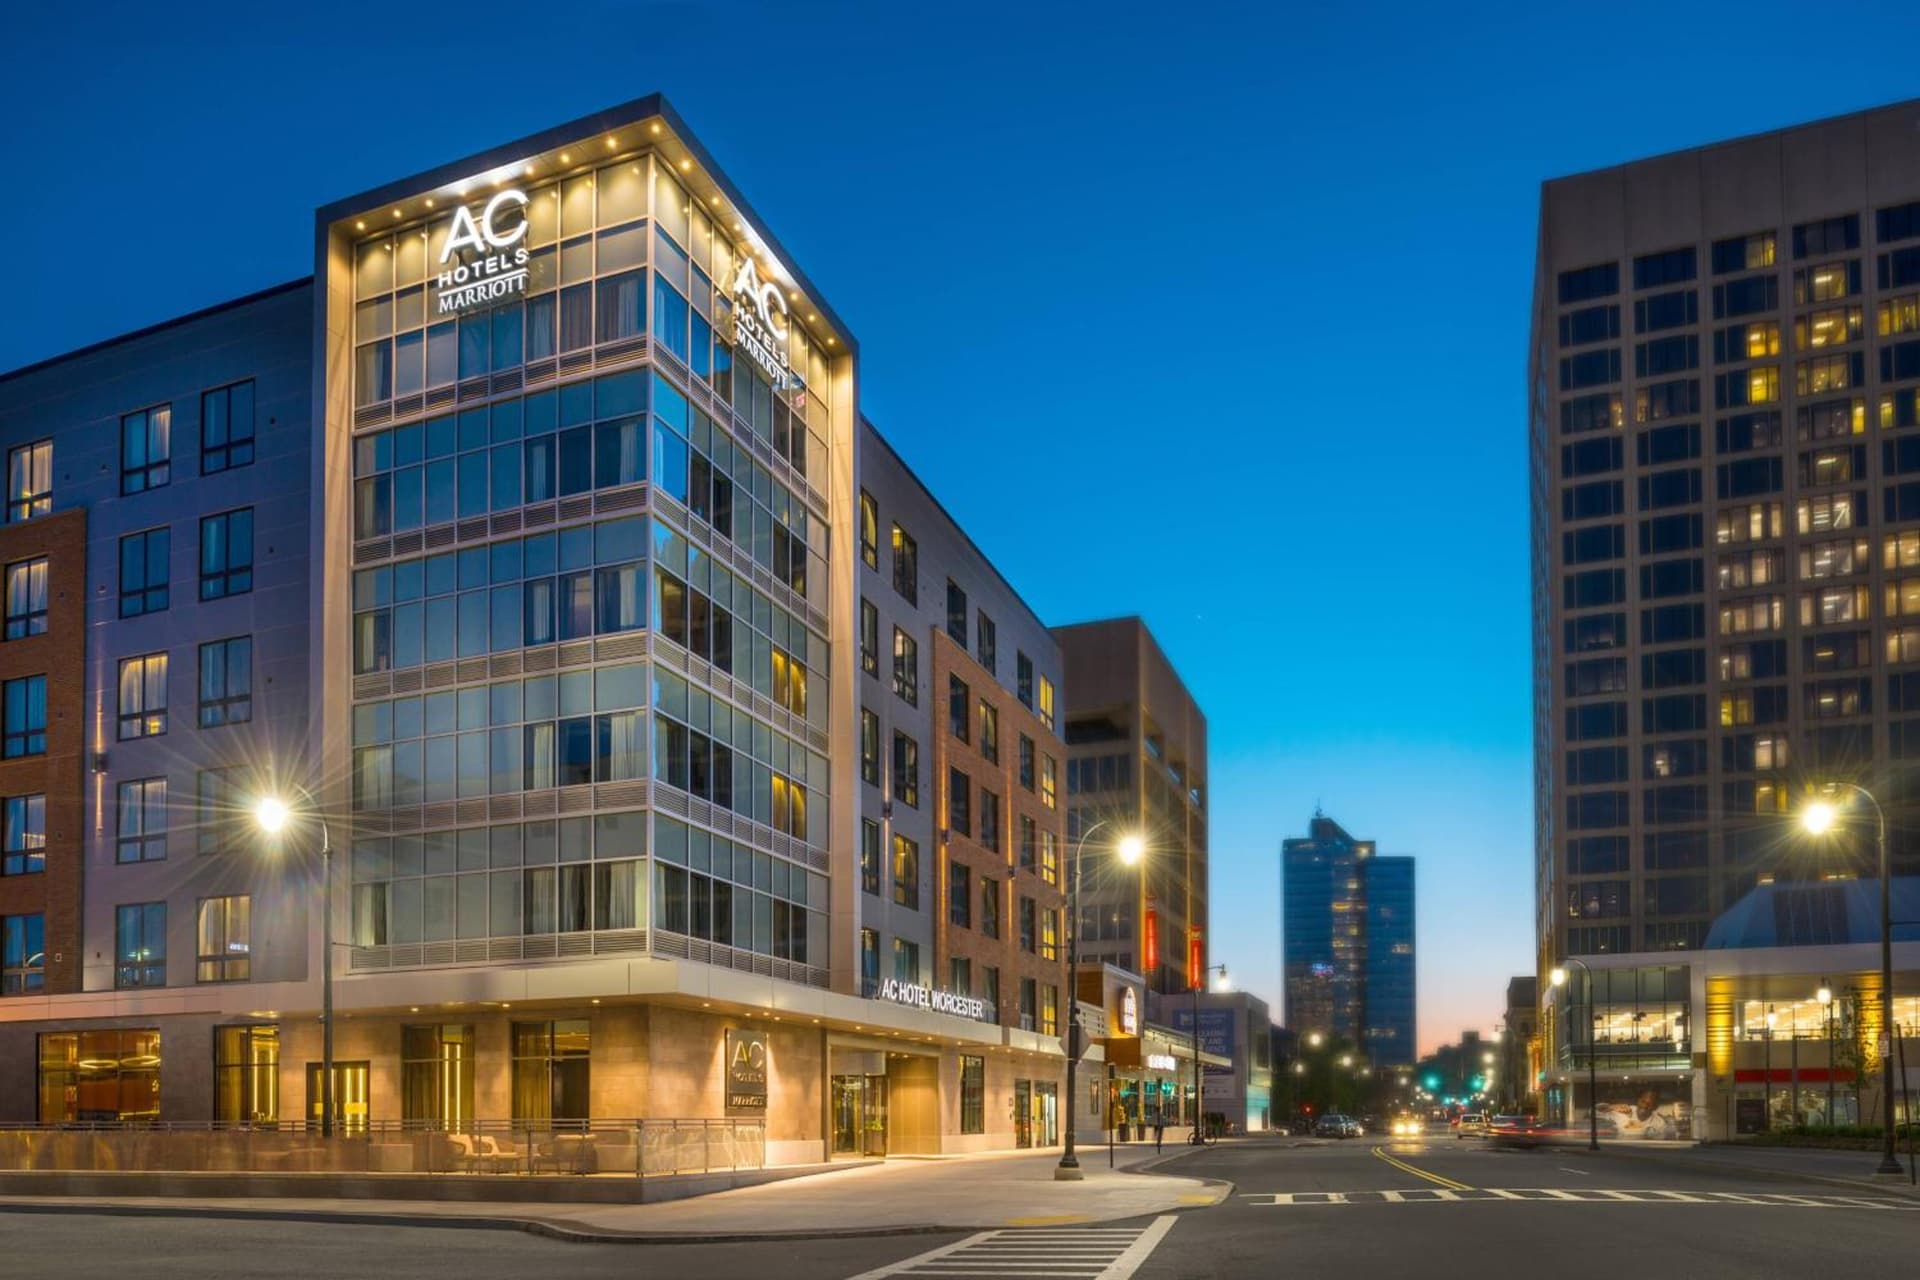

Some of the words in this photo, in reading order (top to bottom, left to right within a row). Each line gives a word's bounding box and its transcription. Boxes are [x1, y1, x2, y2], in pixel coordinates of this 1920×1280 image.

[439, 189, 529, 264] AC
[438, 248, 529, 288] HOTELS
[439, 274, 528, 313] MARRIOTT
[734, 257, 787, 340] AC
[735, 301, 788, 368] HOTELS
[736, 328, 788, 389] MARRIOTT
[882, 978, 898, 1000] AC
[899, 982, 930, 1007] HOTEL
[931, 990, 983, 1017] WORCESTER
[731, 1041, 763, 1068] AC
